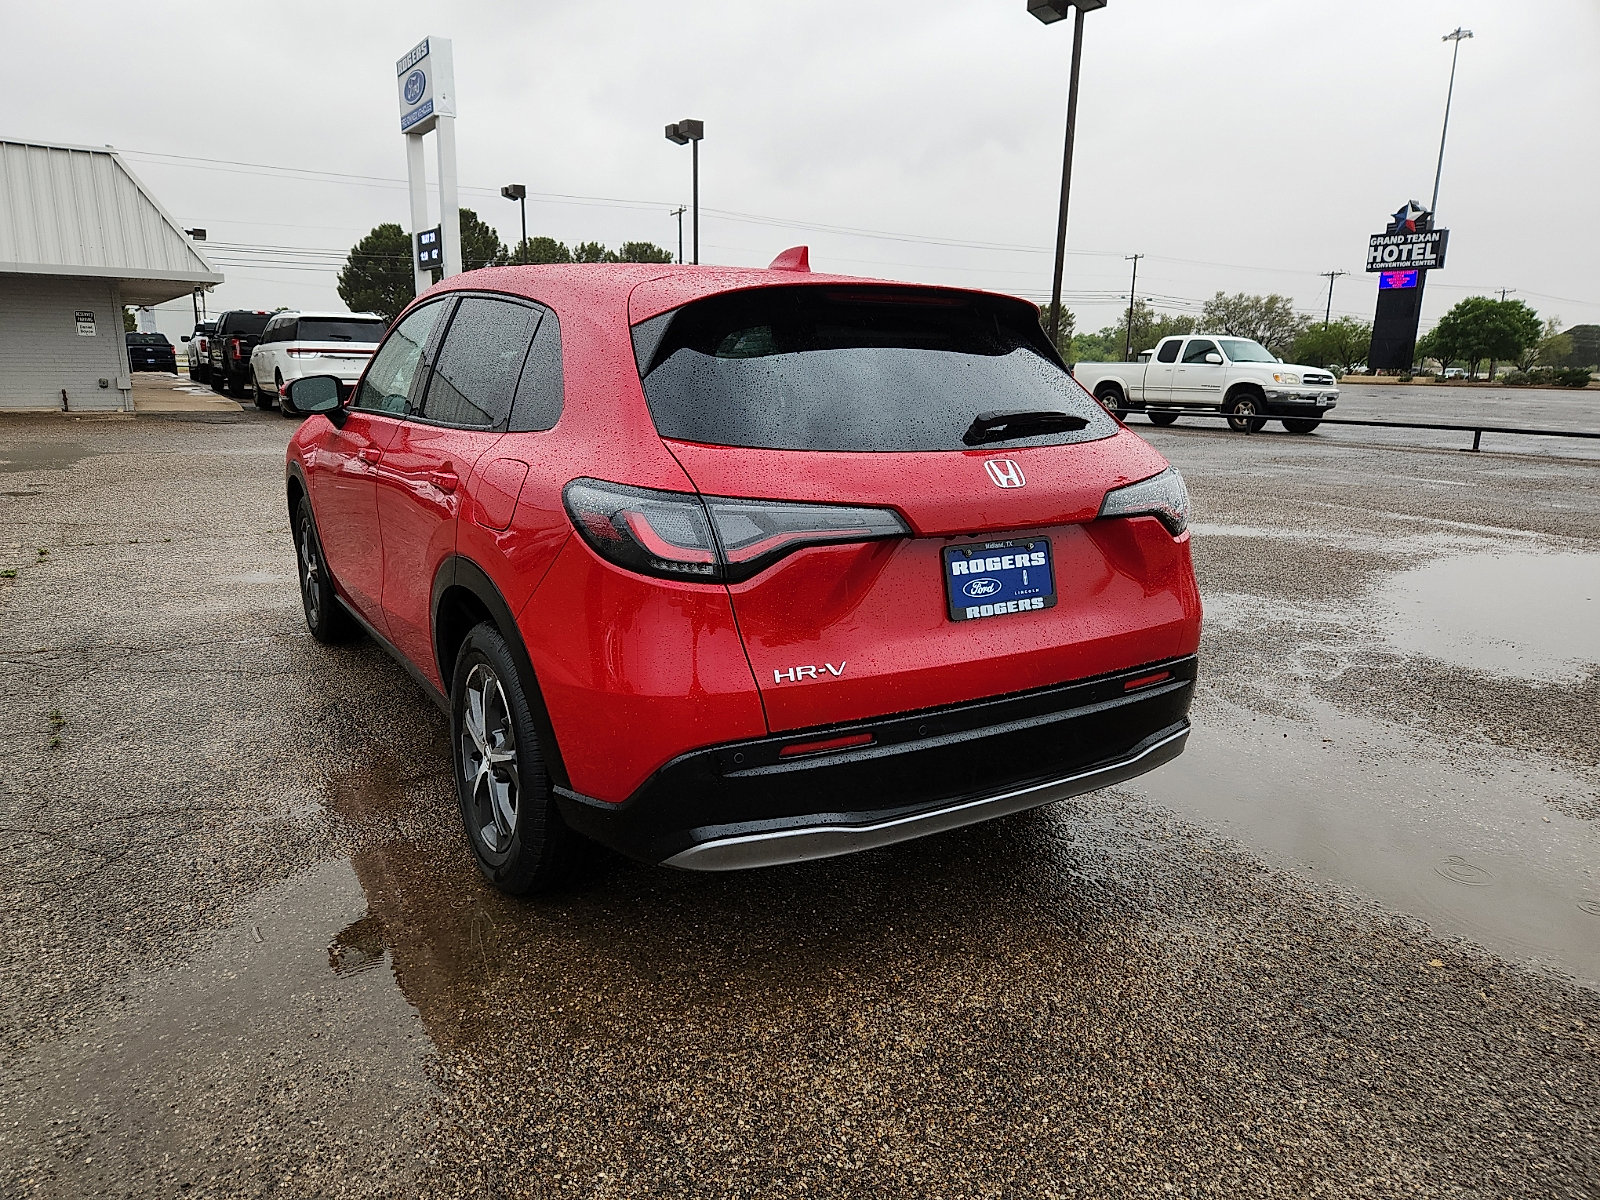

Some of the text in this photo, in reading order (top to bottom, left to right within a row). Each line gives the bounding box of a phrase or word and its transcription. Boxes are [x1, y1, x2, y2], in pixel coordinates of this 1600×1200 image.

[397, 41, 428, 75] ROGERS
[1370, 232, 1440, 246] GRAND TEXAN
[1367, 242, 1437, 263] HOTEL
[1372, 261, 1411, 269] CONVENTION
[951, 551, 1046, 576] ROGERS
[970, 580, 995, 595] Ford
[966, 597, 1045, 619] ROGERS
[773, 660, 847, 684] HR-V
